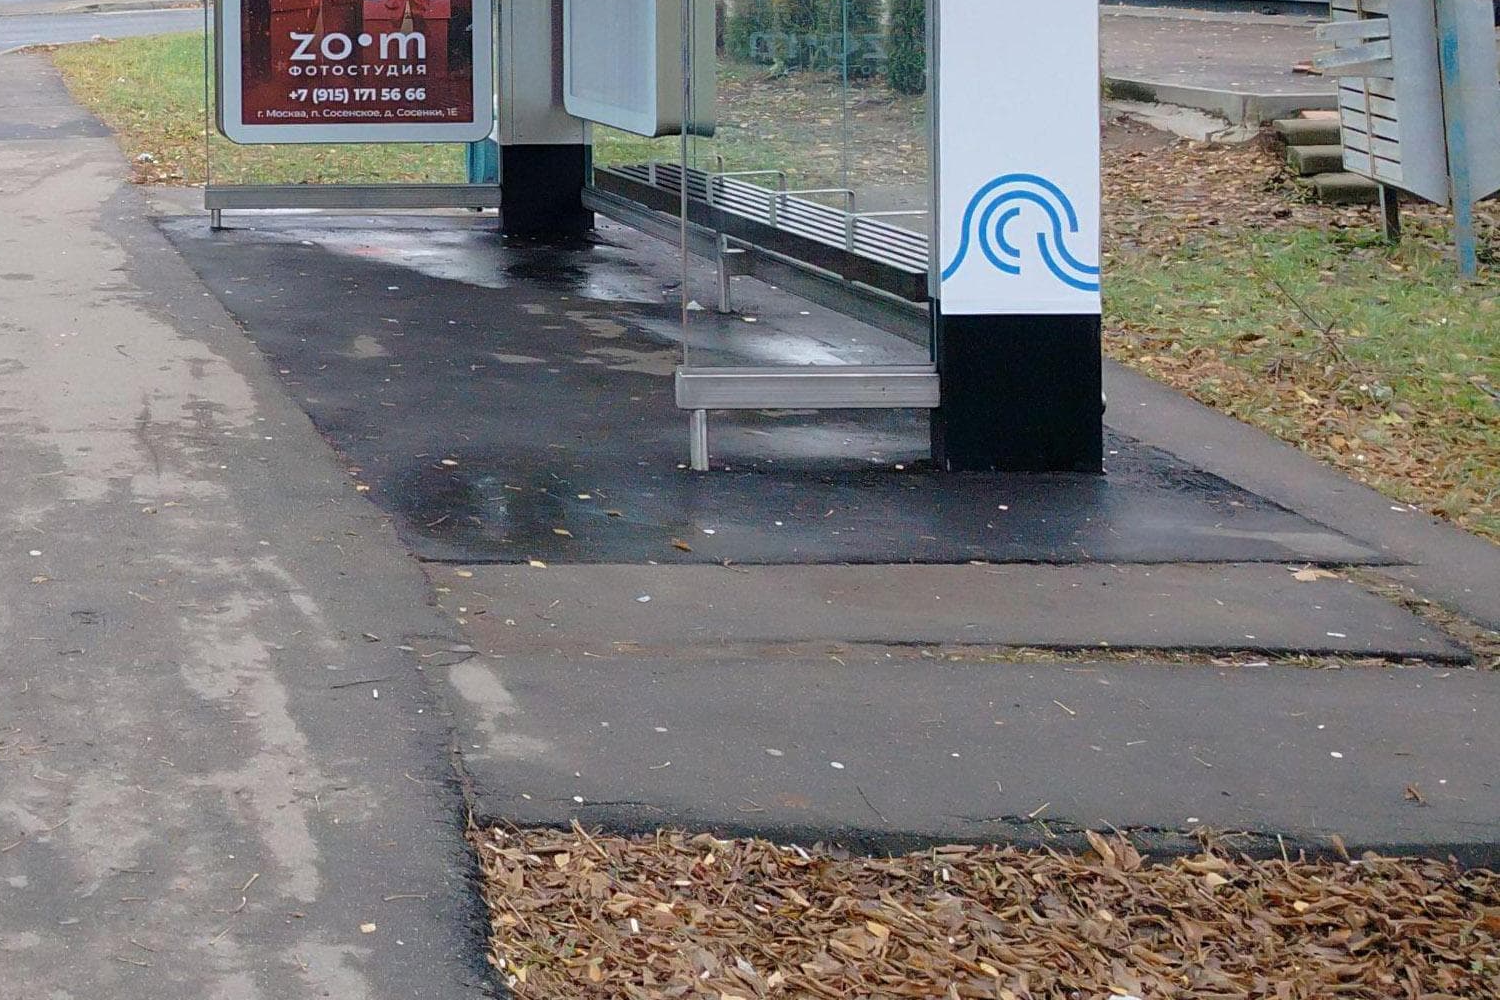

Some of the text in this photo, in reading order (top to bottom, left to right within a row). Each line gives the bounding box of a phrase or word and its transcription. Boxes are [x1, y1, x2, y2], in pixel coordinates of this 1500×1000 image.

[288, 64, 427, 77] ФОТОСТУДИЯ
[288, 87, 426, 104] +7 (915) 171 56 66
[257, 110, 264, 118] г.
[266, 109, 308, 119] Москва,
[311, 110, 320, 118] п.
[322, 108, 382, 118] Сосенское,
[384, 109, 394, 118] д.
[396, 108, 445, 118] Сосенки,
